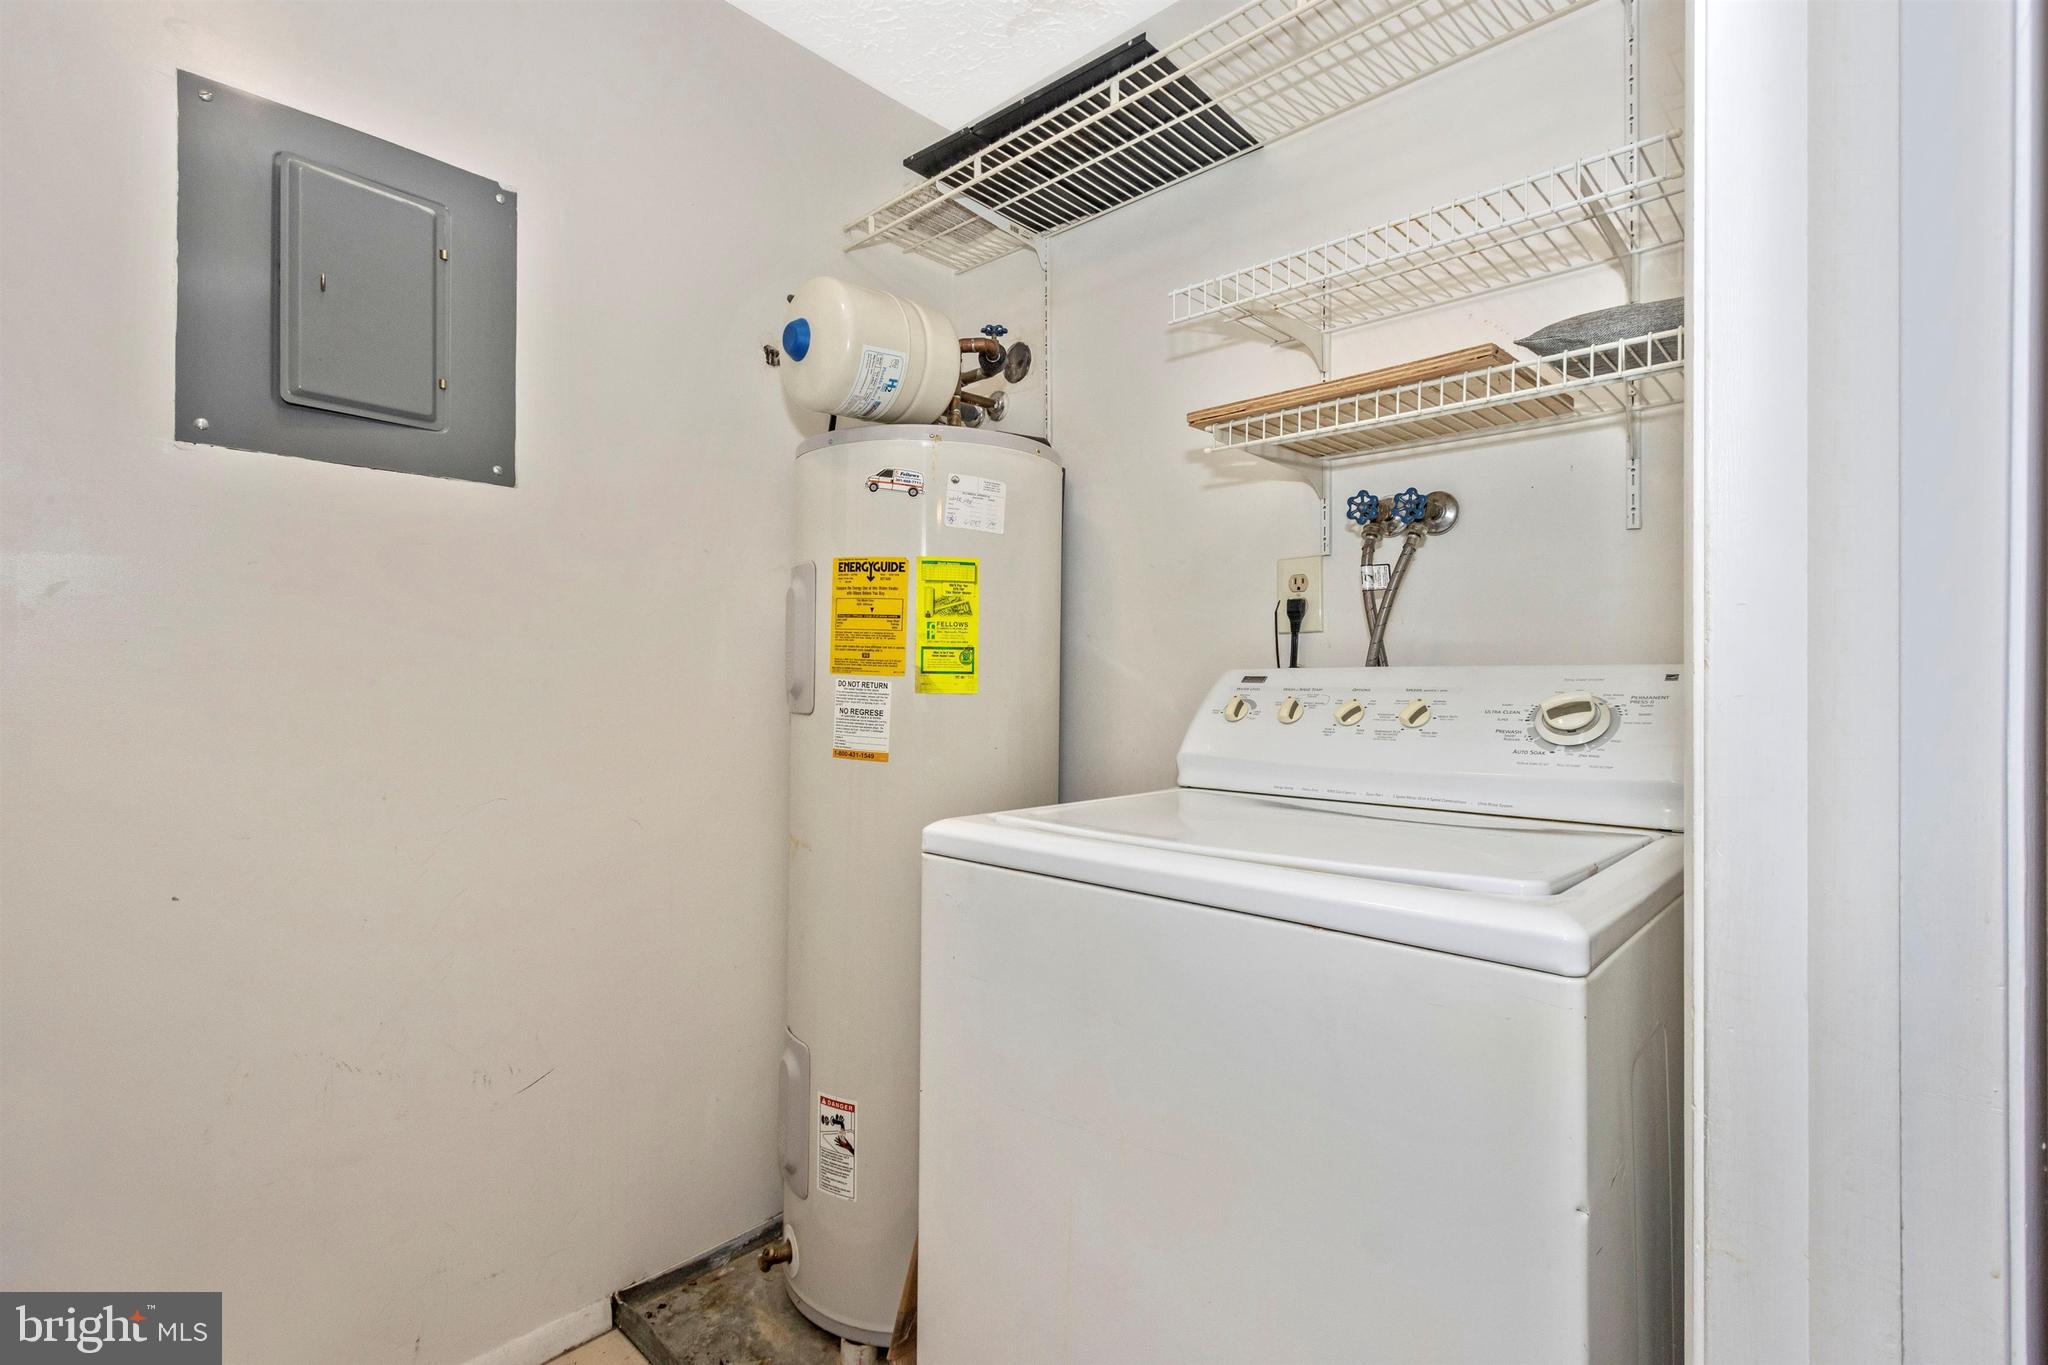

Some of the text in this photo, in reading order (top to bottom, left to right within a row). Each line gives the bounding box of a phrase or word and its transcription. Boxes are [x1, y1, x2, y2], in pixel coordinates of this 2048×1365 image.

[838, 561, 906, 572] ENERGYGUIDE
[850, 708, 884, 717] REGRESE
[828, 1100, 853, 1111] DANGER
